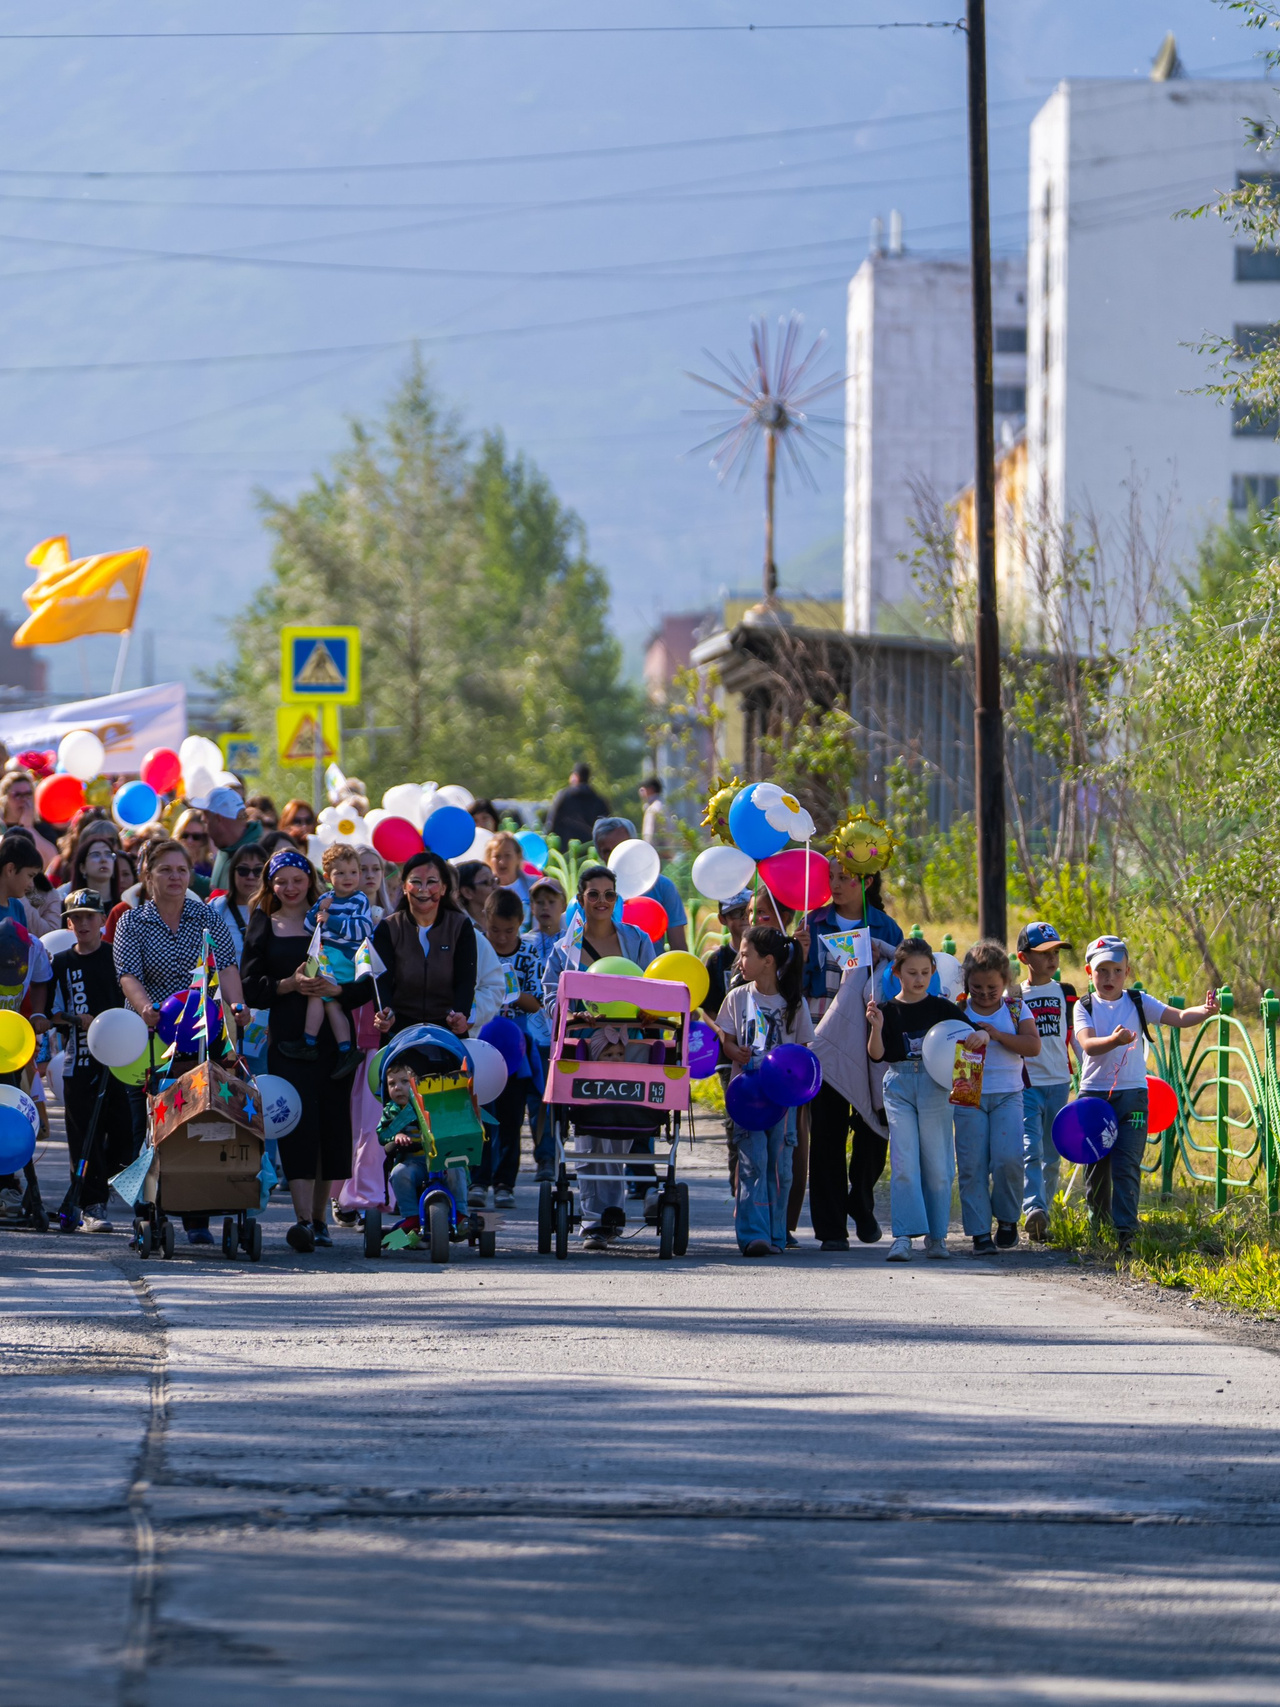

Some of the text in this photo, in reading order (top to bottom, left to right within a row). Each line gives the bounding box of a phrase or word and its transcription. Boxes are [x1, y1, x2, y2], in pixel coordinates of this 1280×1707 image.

[1044, 999, 1059, 1008] ARE
[581, 1081, 664, 1098] СТАСЯ 49
